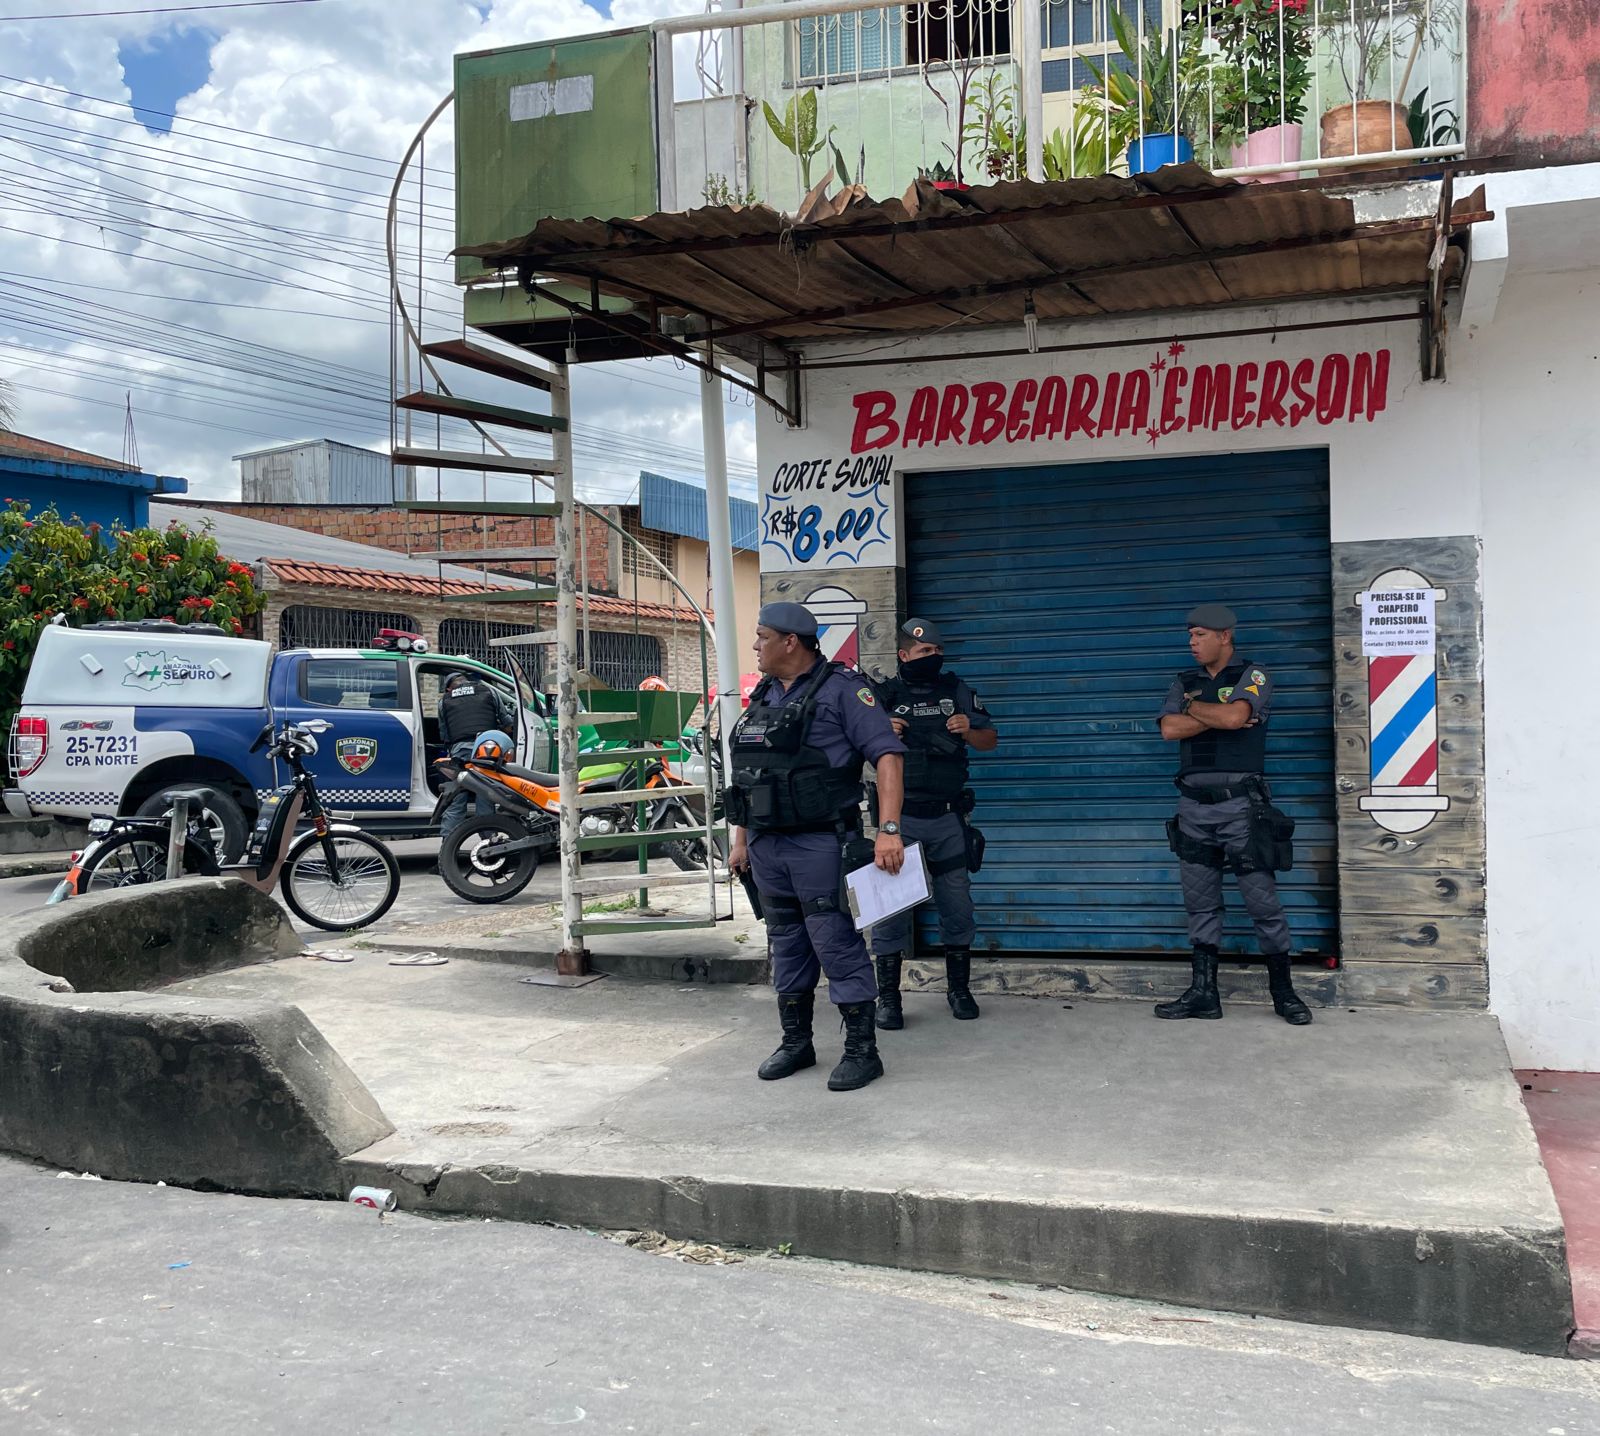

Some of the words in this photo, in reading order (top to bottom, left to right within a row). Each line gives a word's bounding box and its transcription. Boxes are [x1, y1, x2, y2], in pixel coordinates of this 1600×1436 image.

[851, 368, 1150, 454] BARBEARIA
[1159, 349, 1391, 435] EMERSON
[772, 459, 832, 494] CORTE
[832, 454, 893, 492] SOCIAL
[1371, 592, 1414, 601] PRECISA-SE
[1416, 592, 1426, 600] DE
[1378, 604, 1419, 613] CHAPEIRO
[1369, 616, 1428, 625] PROFISSIONAL
[163, 669, 215, 680] SEGURO
[66, 735, 137, 753] 25-7231
[338, 739, 375, 747] AMAZONAS
[66, 756, 91, 766] CPA
[95, 755, 138, 766] NORTE
